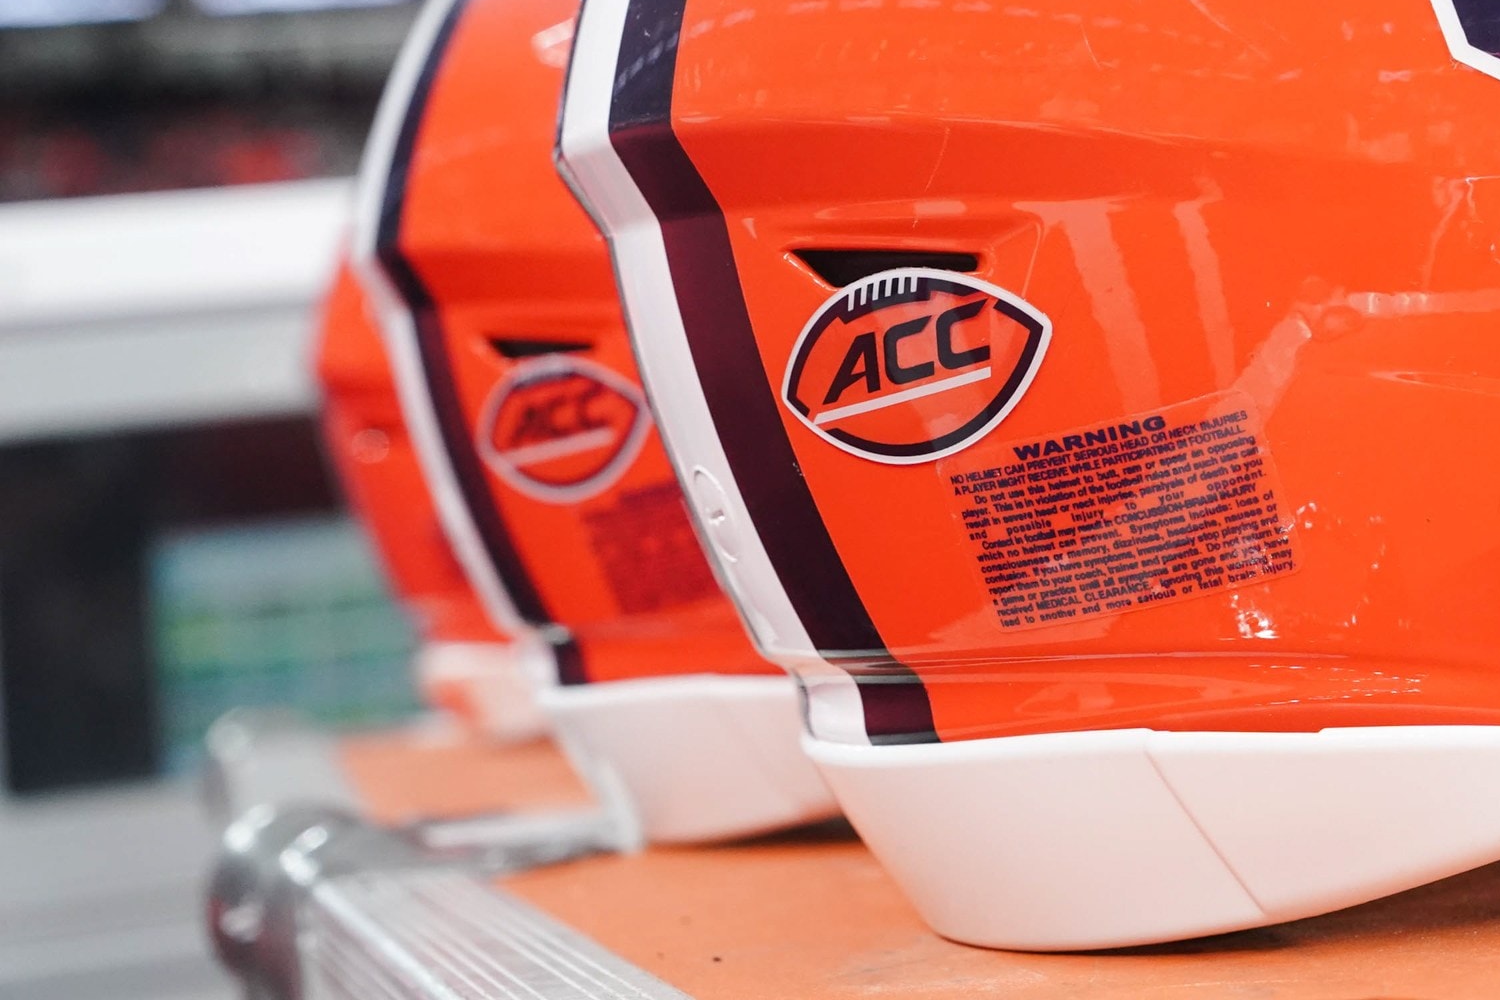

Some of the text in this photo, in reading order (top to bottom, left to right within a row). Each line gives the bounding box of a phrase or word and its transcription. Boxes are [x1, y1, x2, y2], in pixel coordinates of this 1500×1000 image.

[822, 297, 991, 406] ACC
[513, 380, 613, 443] ACC
[1013, 414, 1167, 461] WARNING
[949, 409, 1248, 485] NO HELMET CAN PREVENT SERIOUS HEAD OR NECK INJURIES
[952, 485, 962, 496] A
[960, 479, 997, 494] PLAYER
[1025, 465, 1068, 482] RECEIVE
[1068, 458, 1100, 473] WHILE
[1100, 440, 1176, 466] PARTICIPATING
[973, 494, 988, 504] Do
[989, 490, 1006, 502] not
[1007, 488, 1025, 498] use
[1026, 483, 1046, 495] this
[1047, 475, 1081, 491] helmet
[1095, 467, 1120, 480] butt,
[1121, 463, 1142, 474] ram
[1206, 434, 1256, 455] opposing
[960, 507, 991, 520] player.
[992, 501, 1013, 512] This
[1013, 499, 1024, 509] is
[1023, 497, 1034, 507] in
[1034, 490, 1075, 505] violation
[1087, 483, 1105, 494] the
[1104, 472, 1144, 490] football
[1171, 461, 1191, 475] and
[1192, 454, 1218, 469] such
[1219, 450, 1238, 462] use
[1239, 445, 1258, 457] can
[964, 517, 991, 530] result
[991, 516, 1001, 525] in
[1001, 510, 1033, 523] severe
[1033, 504, 1058, 517] head
[1071, 496, 1095, 509] neck
[1198, 464, 1228, 480] death
[968, 529, 988, 540] and
[1005, 518, 1052, 537] possible
[1070, 508, 1106, 522] injury
[1157, 489, 1185, 505] your
[980, 536, 1014, 550] Contact
[1013, 535, 1024, 544] in
[1023, 528, 1056, 543] football
[1056, 526, 1077, 537] may
[1076, 519, 1103, 533] result
[1102, 517, 1113, 527] in
[1218, 482, 1257, 500] INJURY
[976, 549, 1004, 562] which
[1006, 548, 1020, 557] no
[1020, 540, 1055, 554] helmet
[1057, 537, 1077, 548] can
[1128, 514, 1185, 534] Symptoms
[1234, 495, 1259, 508] loss
[980, 555, 1050, 573] consciousness
[1066, 544, 1110, 558] memory,
[1111, 532, 1164, 549] dizziness,
[1165, 518, 1221, 538] headache,
[983, 570, 1030, 584] confusion.
[1058, 560, 1082, 571] have
[1082, 550, 1135, 568] symptoms,
[1135, 535, 1196, 556] immediately
[1196, 530, 1220, 542] stop
[1220, 520, 1259, 539] playing
[1259, 512, 1279, 526] and
[987, 582, 1015, 596] report
[1015, 579, 1039, 590] them
[1050, 573, 1073, 587] your
[1073, 566, 1106, 580] coach,
[1106, 560, 1139, 574] trainer
[1140, 554, 1160, 567] and
[1205, 541, 1221, 552] Do
[1222, 535, 1240, 548] not
[996, 602, 1034, 617] received
[1035, 594, 1082, 610] MEDICAL
[1083, 580, 1153, 602] CLEARANCE.
[1203, 565, 1224, 577] this
[1270, 548, 1293, 561] may
[999, 616, 1021, 627] lead
[1038, 608, 1077, 621] another
[1081, 602, 1100, 614] and
[1104, 597, 1132, 609] more
[1136, 588, 1176, 603] serious
[1198, 575, 1222, 589] fatal
[1261, 560, 1296, 575] injury.
[1000, 594, 1025, 606] game
[1039, 585, 1076, 600] practice
[1117, 566, 1168, 585] symptoms
[1170, 561, 1188, 572] are
[1189, 555, 1216, 570] gone
[1218, 547, 1238, 561] and
